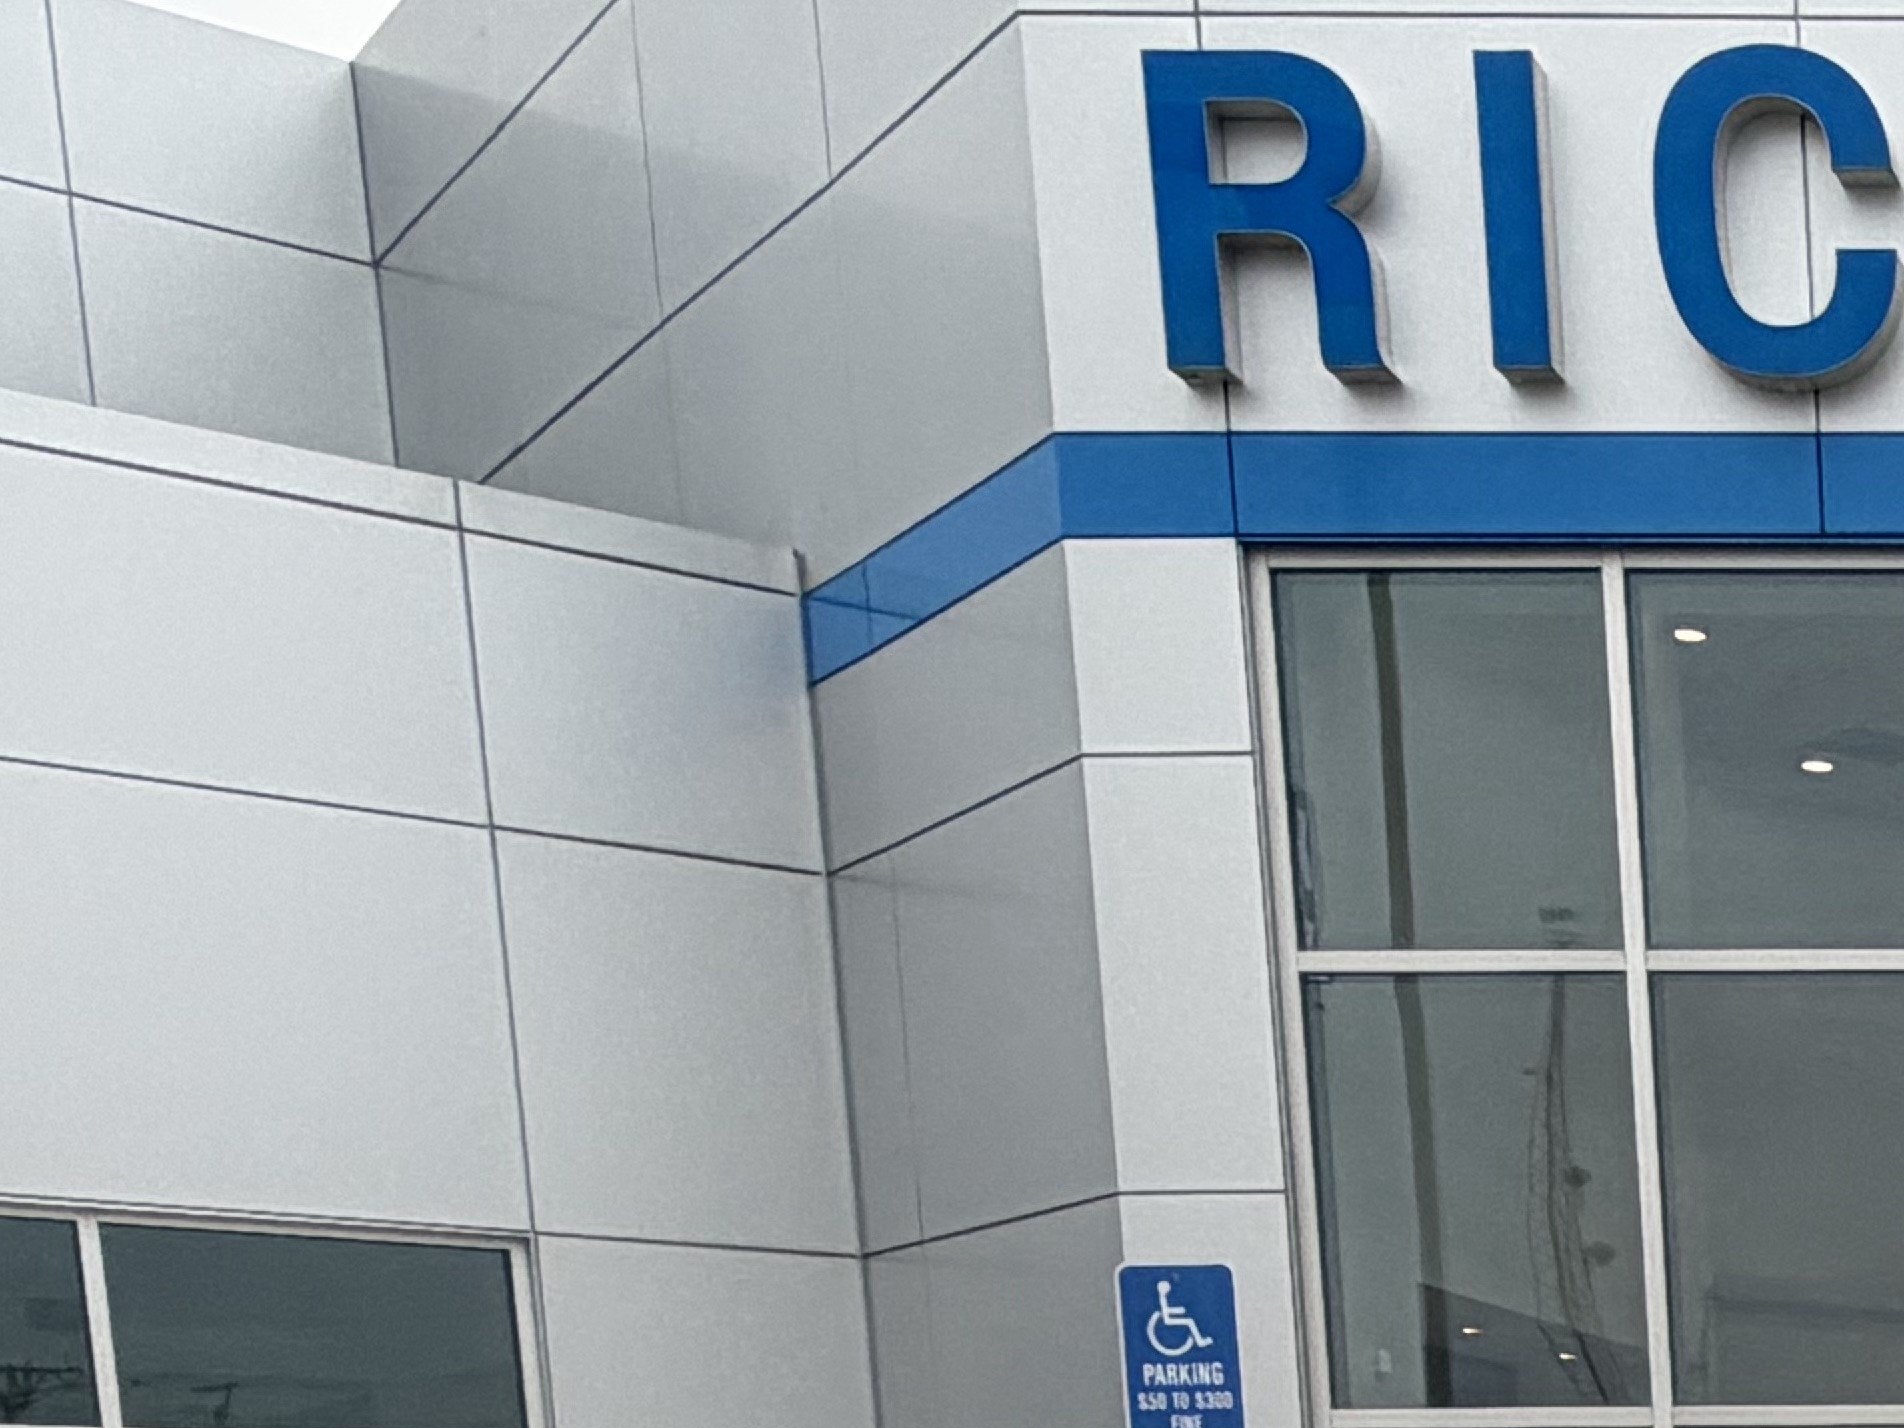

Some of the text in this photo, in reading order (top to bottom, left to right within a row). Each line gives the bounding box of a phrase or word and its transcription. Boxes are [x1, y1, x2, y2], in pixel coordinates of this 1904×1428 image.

[1142, 1362, 1224, 1386] PARKING
[1137, 1390, 1234, 1411] $50 TO $300
